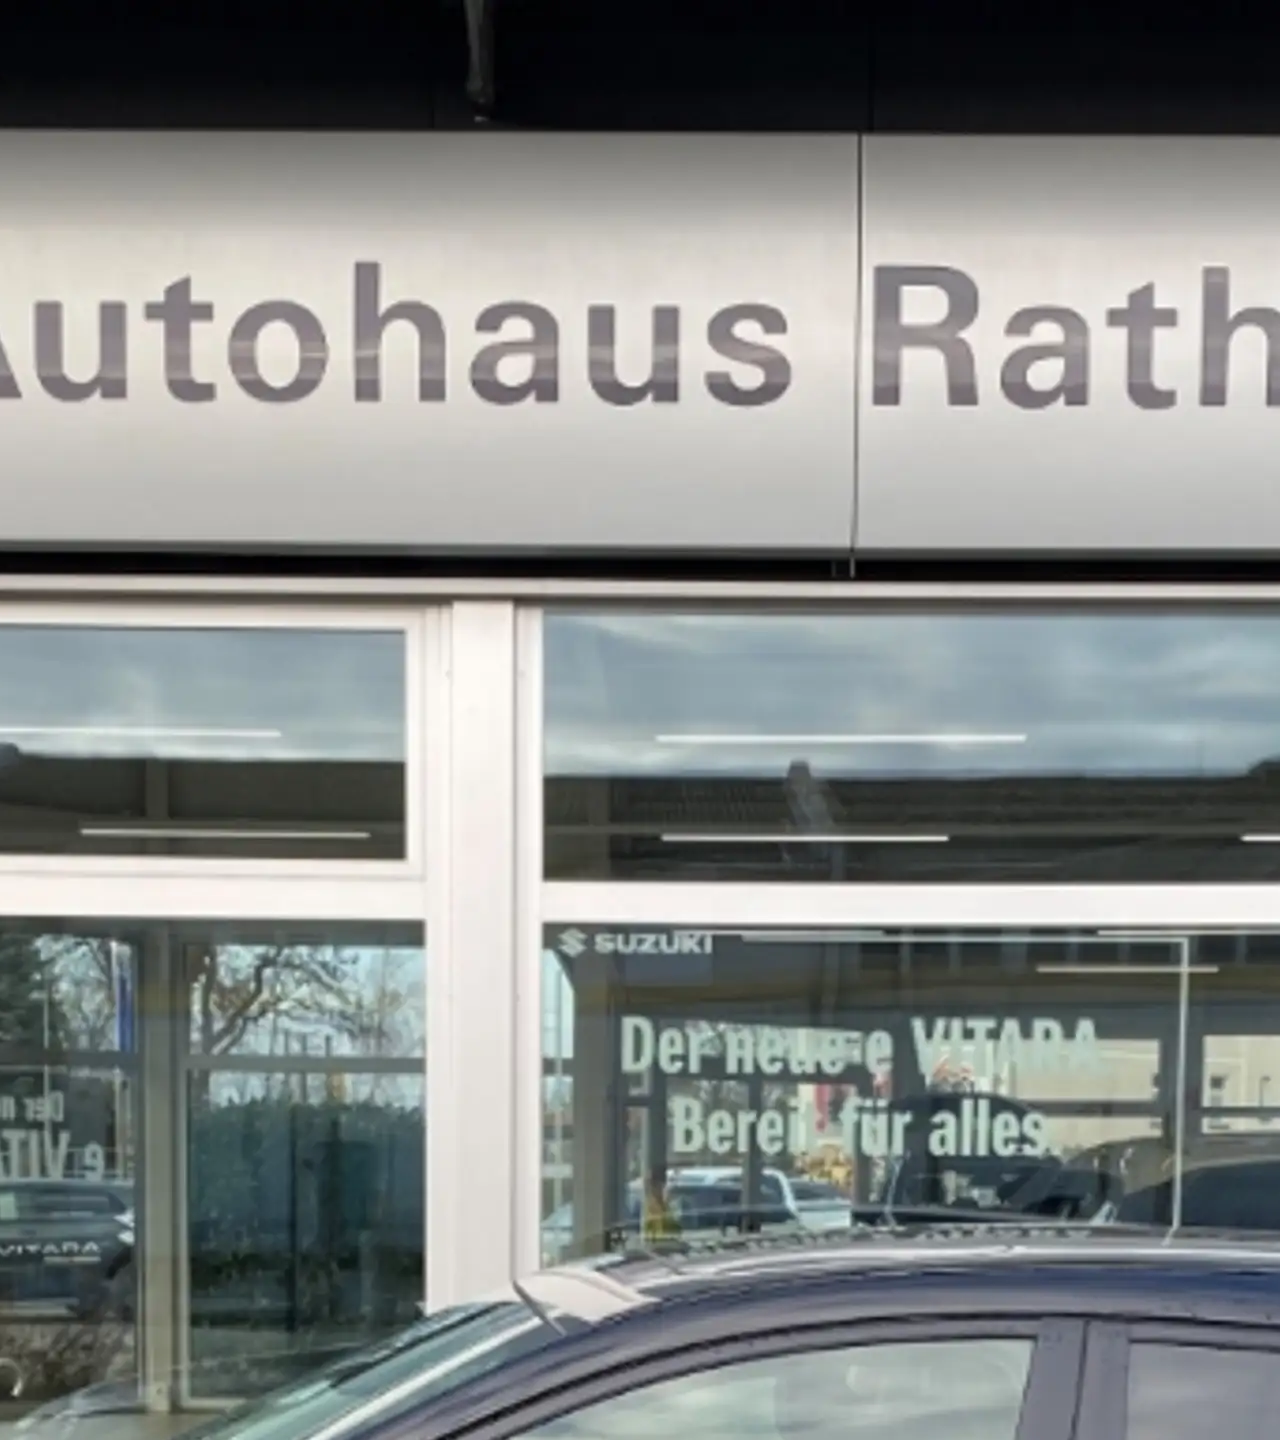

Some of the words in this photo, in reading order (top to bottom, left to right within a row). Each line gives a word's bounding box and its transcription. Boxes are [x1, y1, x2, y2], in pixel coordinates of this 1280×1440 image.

[594, 932, 713, 954] SUZUKI
[621, 1015, 704, 1074] Der
[724, 1026, 846, 1076] neue
[910, 1016, 1098, 1084] VITARA
[673, 1096, 820, 1155] Berei
[839, 1097, 913, 1157] für
